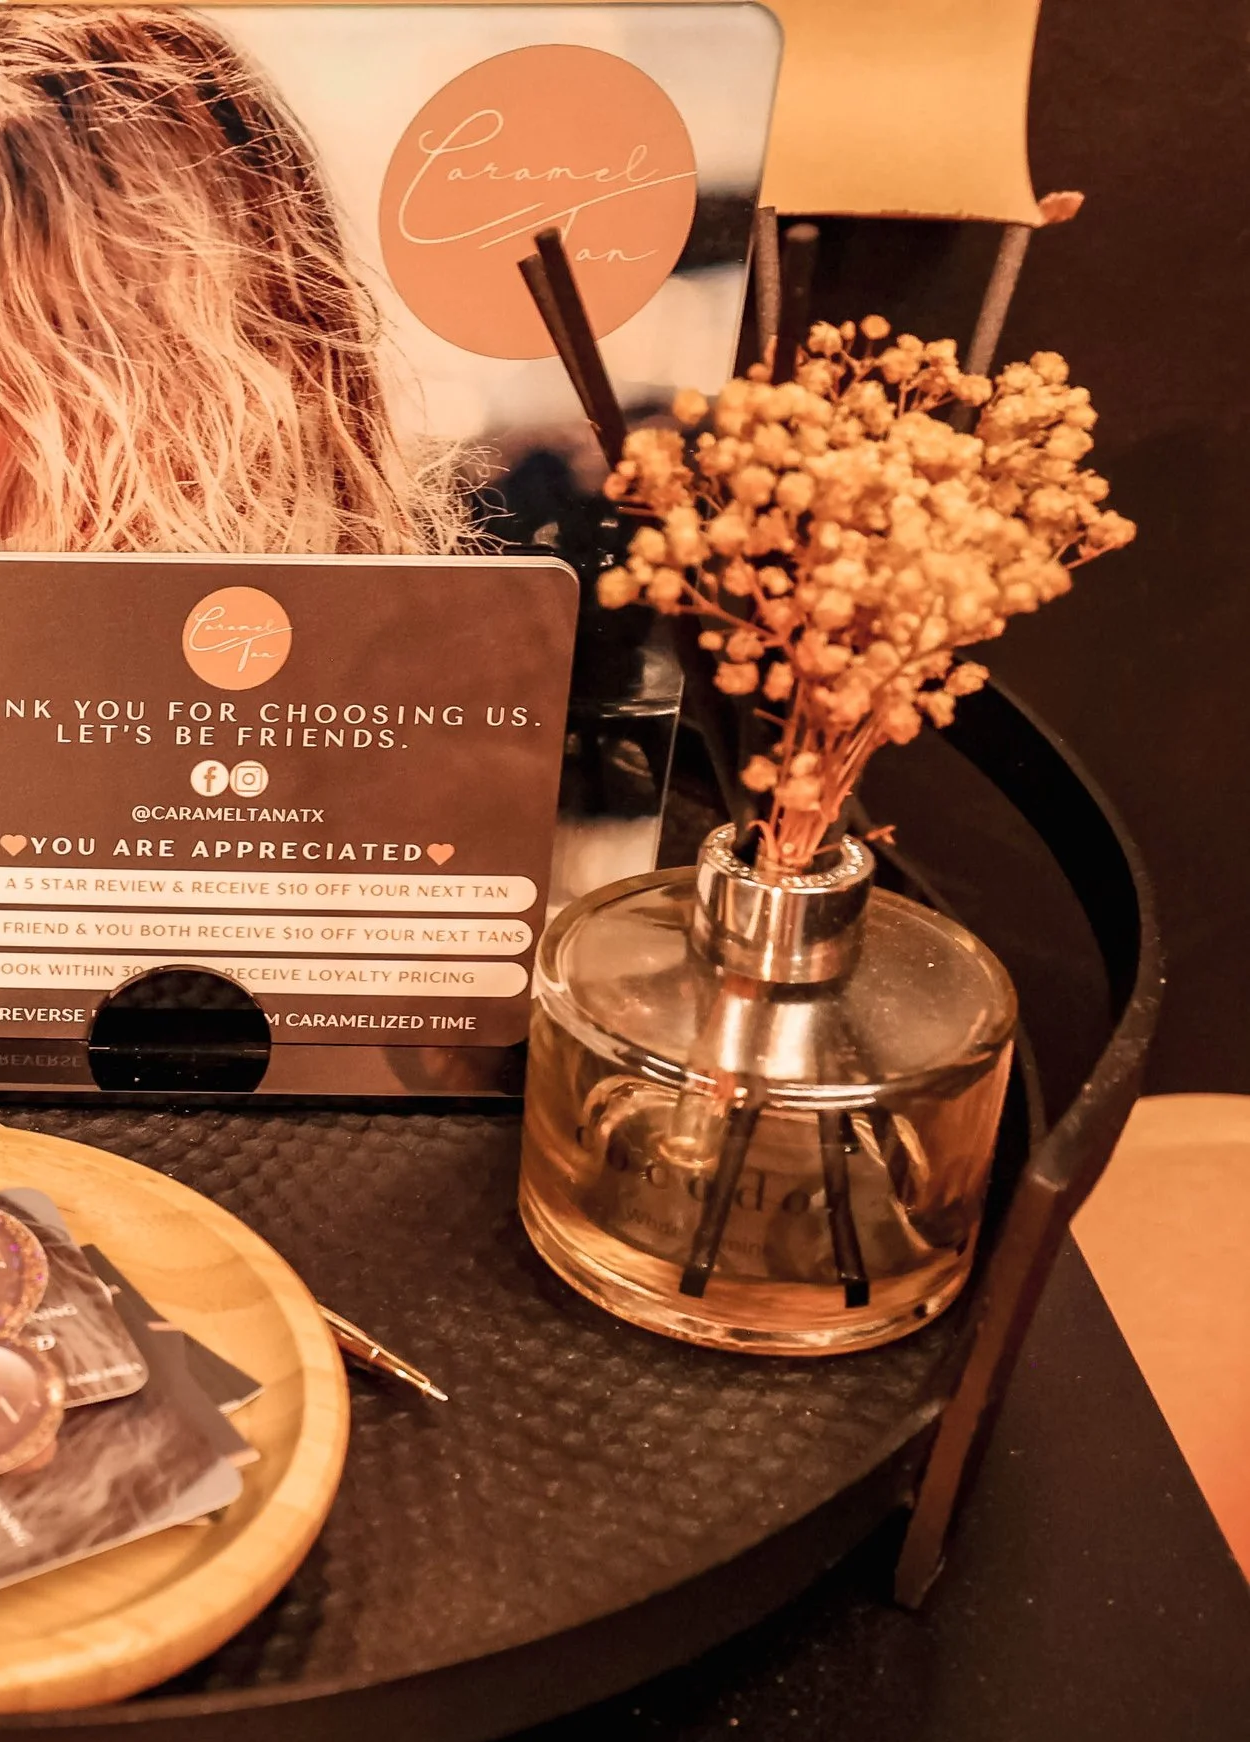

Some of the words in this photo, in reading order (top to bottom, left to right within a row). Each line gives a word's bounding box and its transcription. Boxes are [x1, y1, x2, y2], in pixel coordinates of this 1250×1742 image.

[398, 109, 660, 244] Caramel
[189, 606, 276, 651] Caramel
[216, 627, 293, 673] Tan
[74, 699, 145, 721] YOU
[168, 701, 237, 723] FOR
[259, 703, 464, 725] CHOOSING
[486, 706, 542, 727] US.
[56, 723, 152, 745] LET'S
[175, 725, 215, 746] BE
[237, 727, 409, 749] FRIENDS.
[131, 805, 325, 824] @CARAMELTANATX
[30, 836, 96, 857] YOU
[113, 838, 176, 858] ARE
[192, 840, 423, 862] APPRECIATED
[4, 877, 18, 890] A
[23, 877, 34, 890] 5
[40, 877, 87, 891] STAR
[94, 879, 167, 893] REVIEW
[172, 880, 184, 894] &
[191, 881, 270, 895] RECEIVE
[276, 882, 308, 897] $10
[315, 883, 352, 896] OFF
[358, 883, 410, 898] YOUR
[417, 885, 469, 898] NEXT
[473, 885, 509, 899] TAN
[3, 921, 69, 935] FRIEND
[75, 922, 87, 936] &
[94, 923, 134, 937] YOU
[140, 924, 190, 938] BOTH
[197, 925, 276, 939] RECEIVE
[282, 926, 313, 940] $10
[320, 927, 357, 941] OFF
[363, 928, 415, 942] YOUR
[421, 929, 475, 943] NEXT
[477, 930, 525, 943] TANS
[47, 963, 115, 977] WITHIN
[121, 964, 144, 978] 30
[224, 967, 302, 981] RECEIVE
[308, 969, 393, 983] LOYALTY
[399, 970, 475, 984] PRICING
[0, 1007, 86, 1023] REVERSE
[285, 1012, 424, 1029] CARAMELIZED
[429, 1015, 477, 1030] TIME
